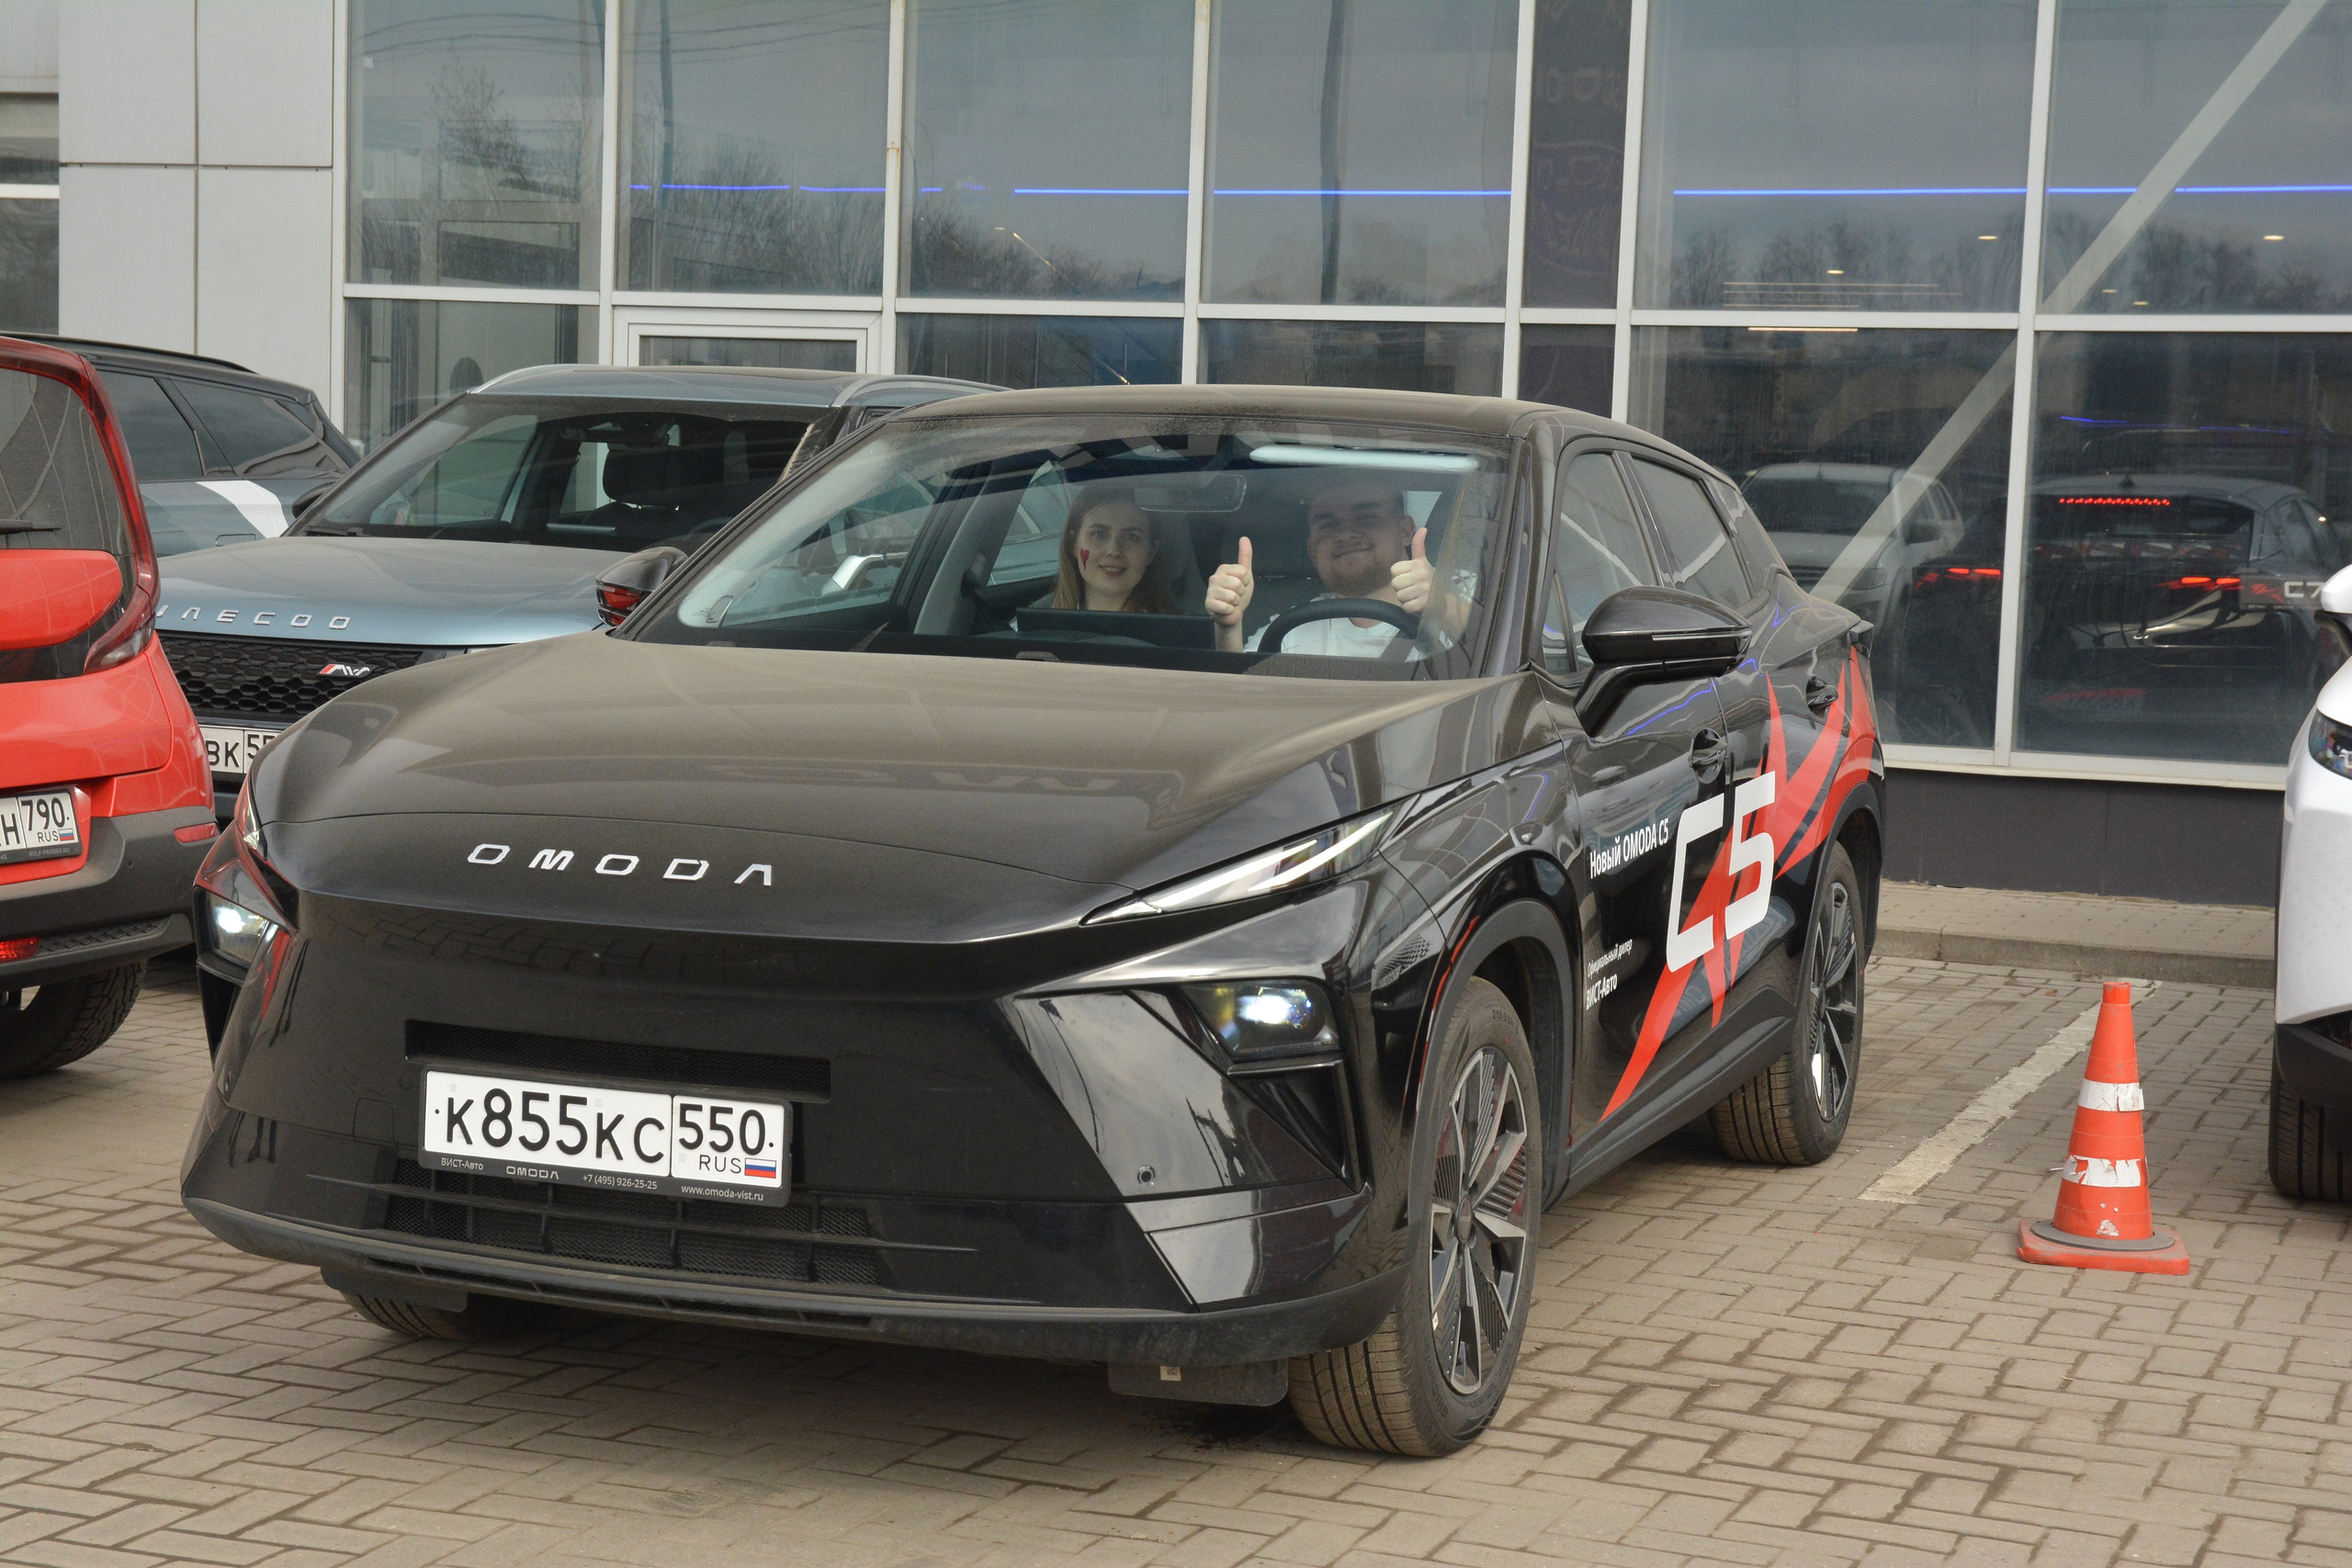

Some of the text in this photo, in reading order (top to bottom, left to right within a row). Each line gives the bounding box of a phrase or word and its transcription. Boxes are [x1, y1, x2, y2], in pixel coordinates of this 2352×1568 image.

[20, 796, 65, 831] 790
[37, 830, 59, 843] RUS
[1589, 818, 1669, 880] Новый OMODA C5
[467, 843, 772, 886] OMODA
[1666, 771, 1776, 974] C5
[678, 1103, 766, 1156] 550
[441, 1157, 764, 1201] ВИСТ-Авто OMODA +7 (495) 926-25-25 www.omoda-vist.ru
[698, 1154, 742, 1175] RUS
